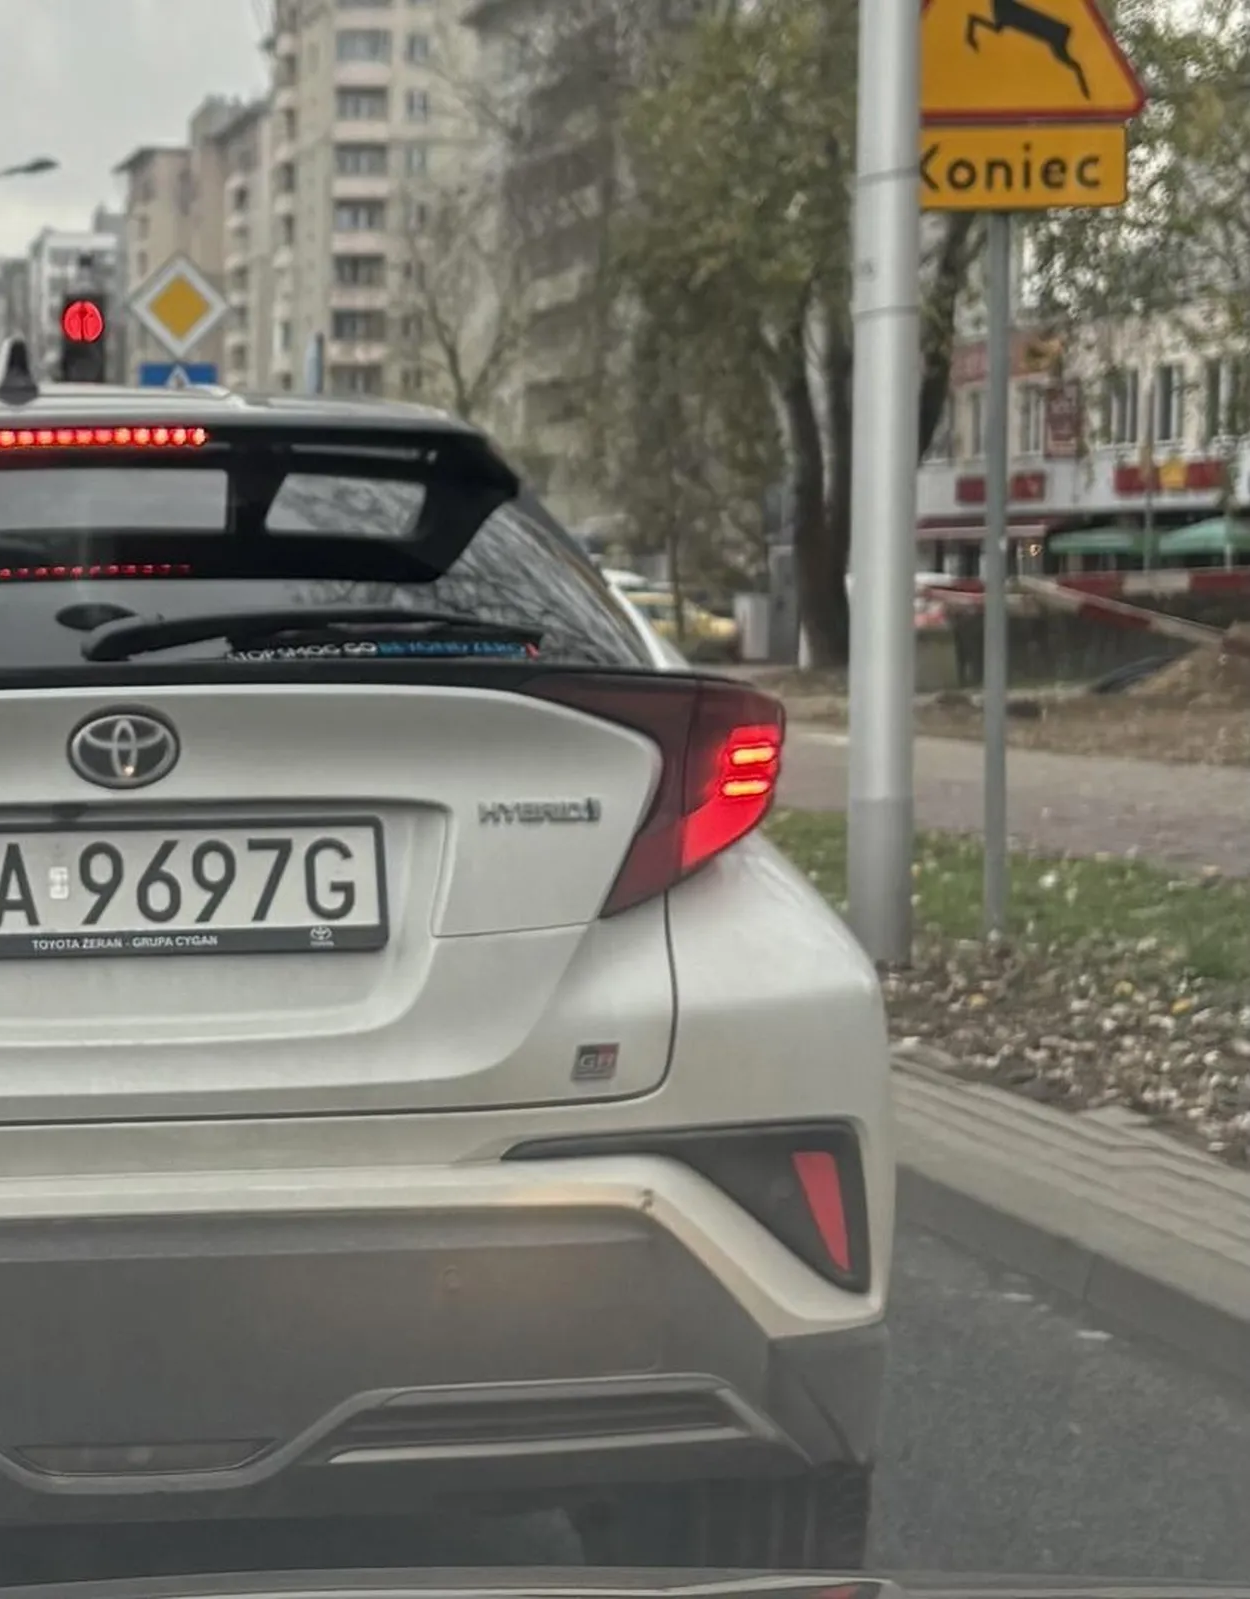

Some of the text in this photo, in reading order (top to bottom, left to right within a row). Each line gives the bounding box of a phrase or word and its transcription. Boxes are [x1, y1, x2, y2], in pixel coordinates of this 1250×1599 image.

[919, 142, 1101, 192] Koniec
[78, 837, 356, 926] 9697G
[31, 938, 80, 950] TOYOTA
[132, 936, 174, 948] GRUPA
[175, 935, 219, 947] CYGAN
